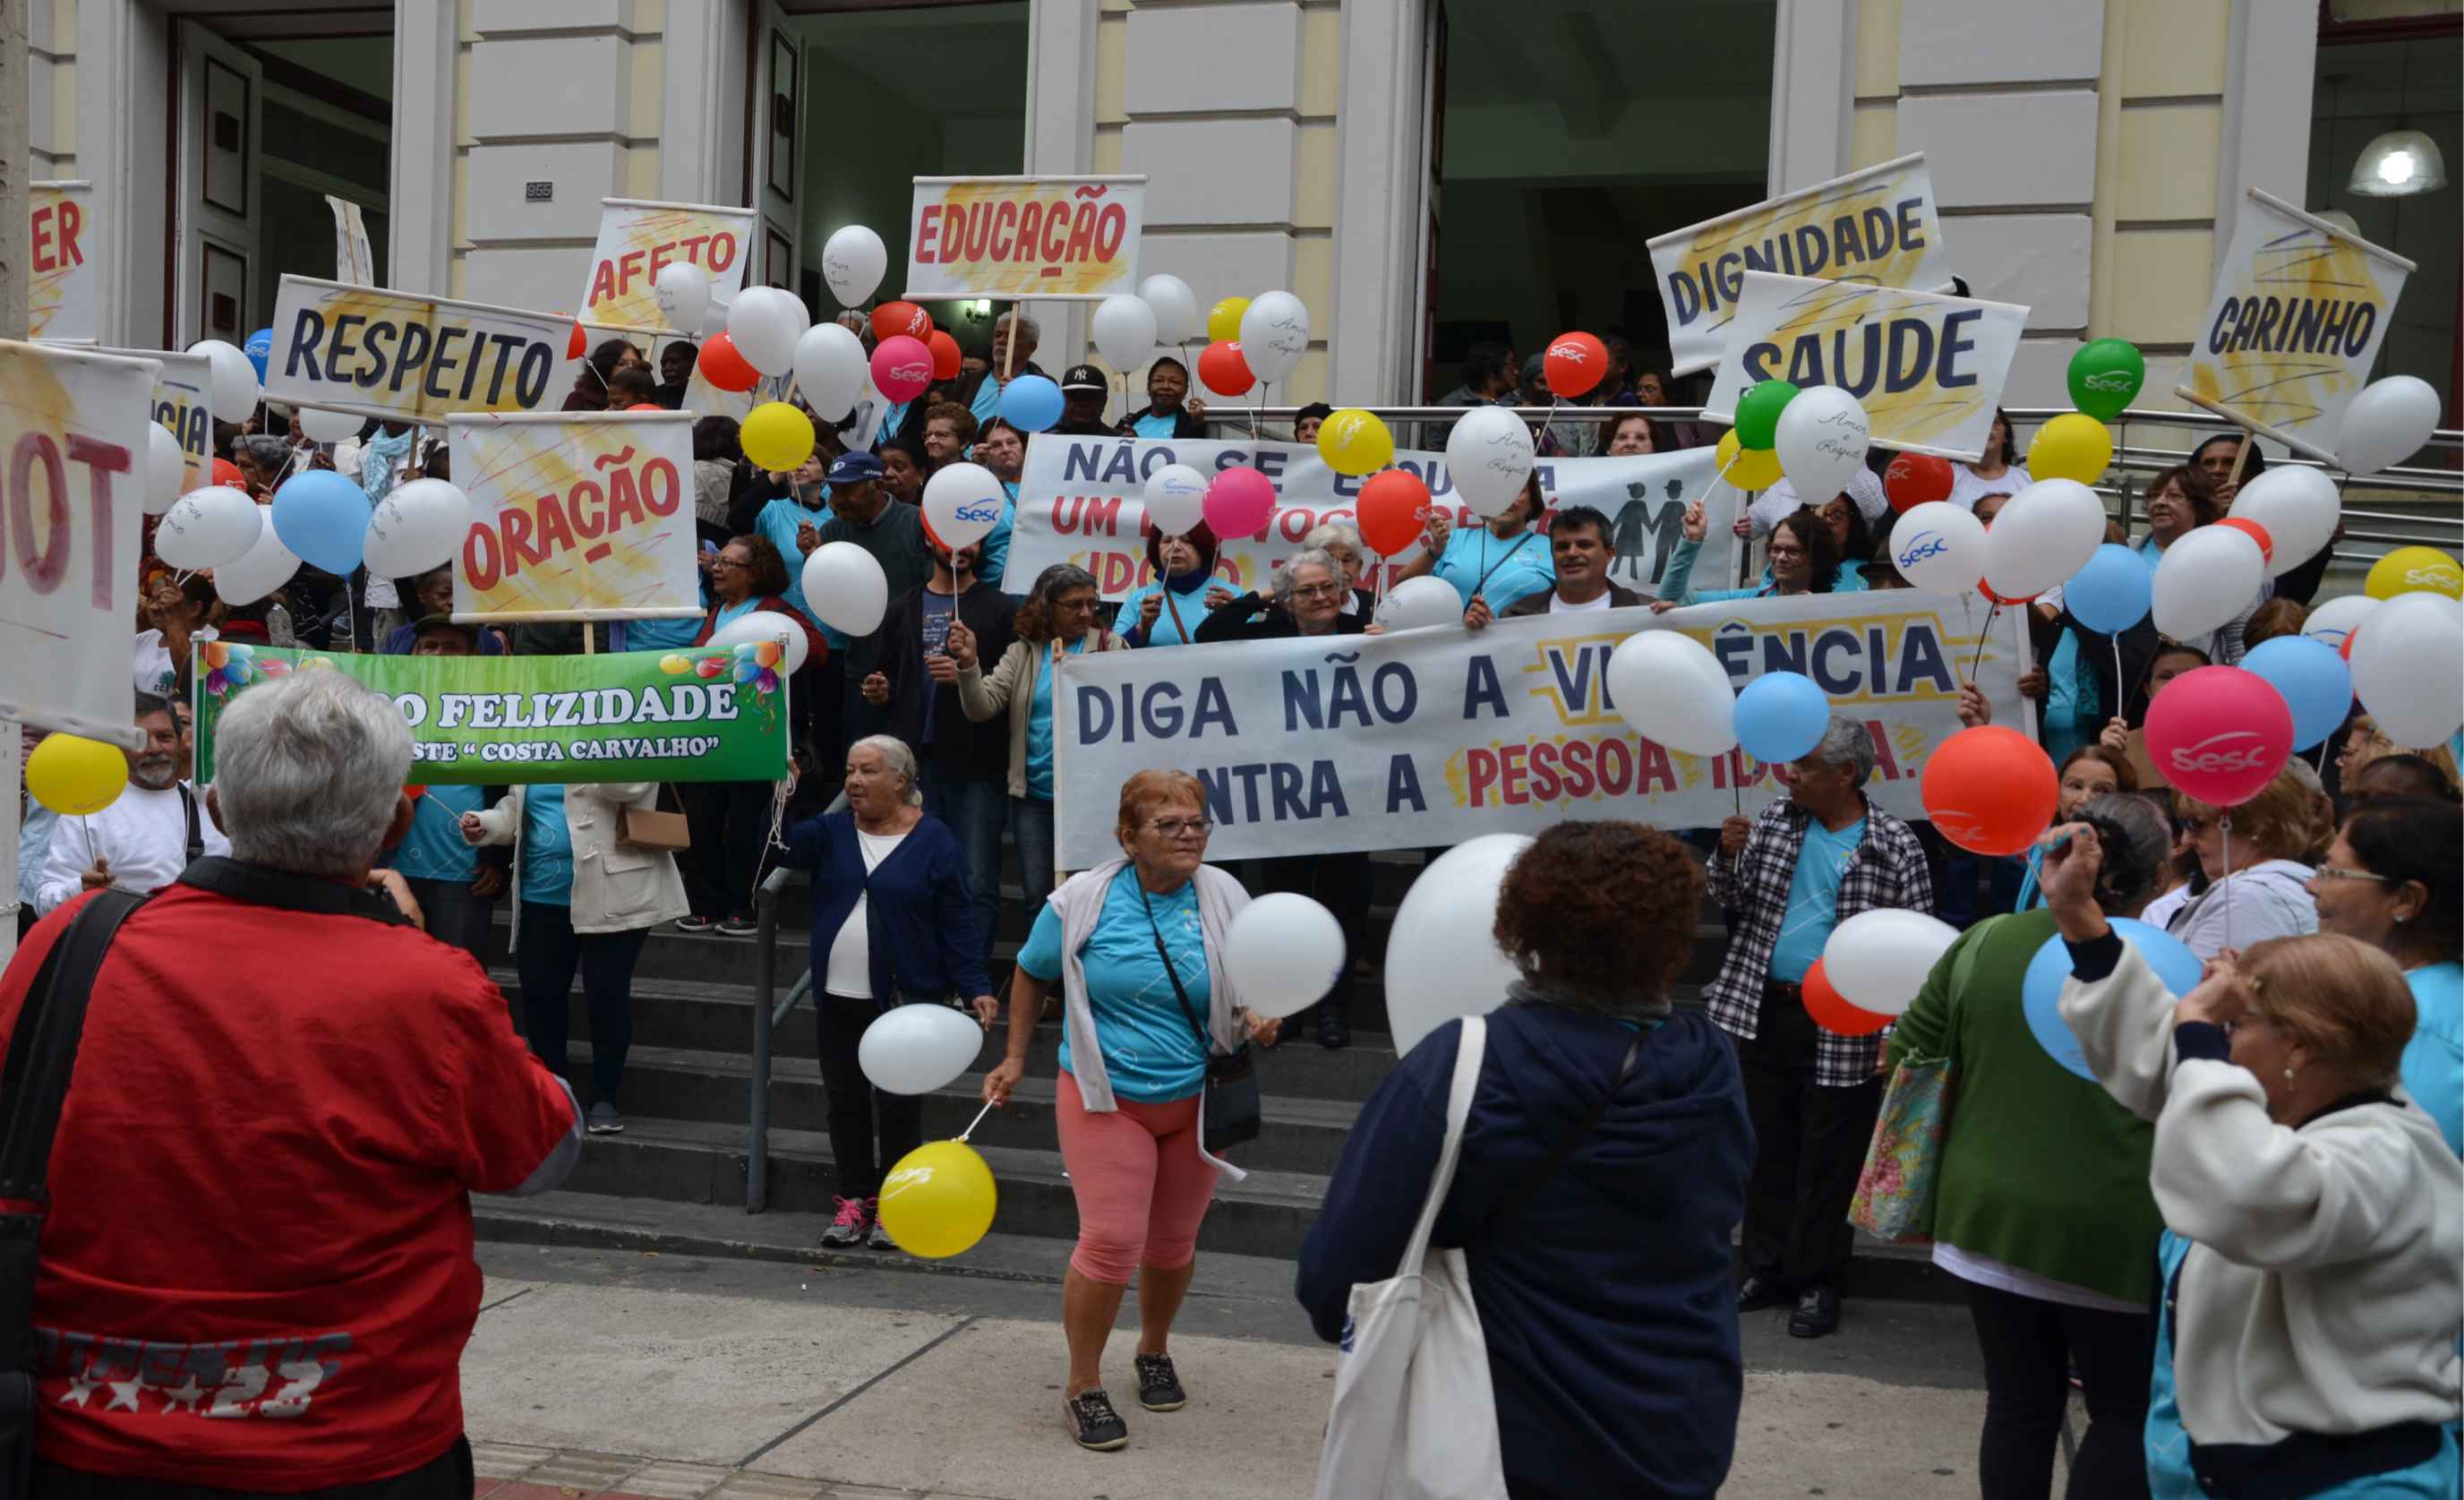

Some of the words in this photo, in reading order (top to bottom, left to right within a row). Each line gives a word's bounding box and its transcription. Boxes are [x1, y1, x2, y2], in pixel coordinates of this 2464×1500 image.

[31, 201, 84, 273] ER
[915, 184, 1125, 277] EDUCAÇÃO
[1668, 197, 1925, 326] DIGNIDADE
[285, 307, 552, 409] RESPEITO
[1740, 309, 1983, 399] SAÚDE
[2208, 296, 2376, 357] CARINHO
[0, 431, 132, 612] OT
[463, 446, 680, 592] ORAÇÃO
[1051, 496, 1123, 537] UM
[437, 681, 740, 729] FELIZIDADE
[1077, 676, 1239, 745] DIGA
[1281, 652, 1418, 732] NÃO
[1464, 656, 1509, 719] A
[1548, 621, 1955, 712] VIÊNCIA
[480, 740, 565, 763] COSTA
[1196, 759, 1348, 826] NTRA
[1386, 753, 1428, 814] A
[1467, 733, 1678, 808] PESSOA
